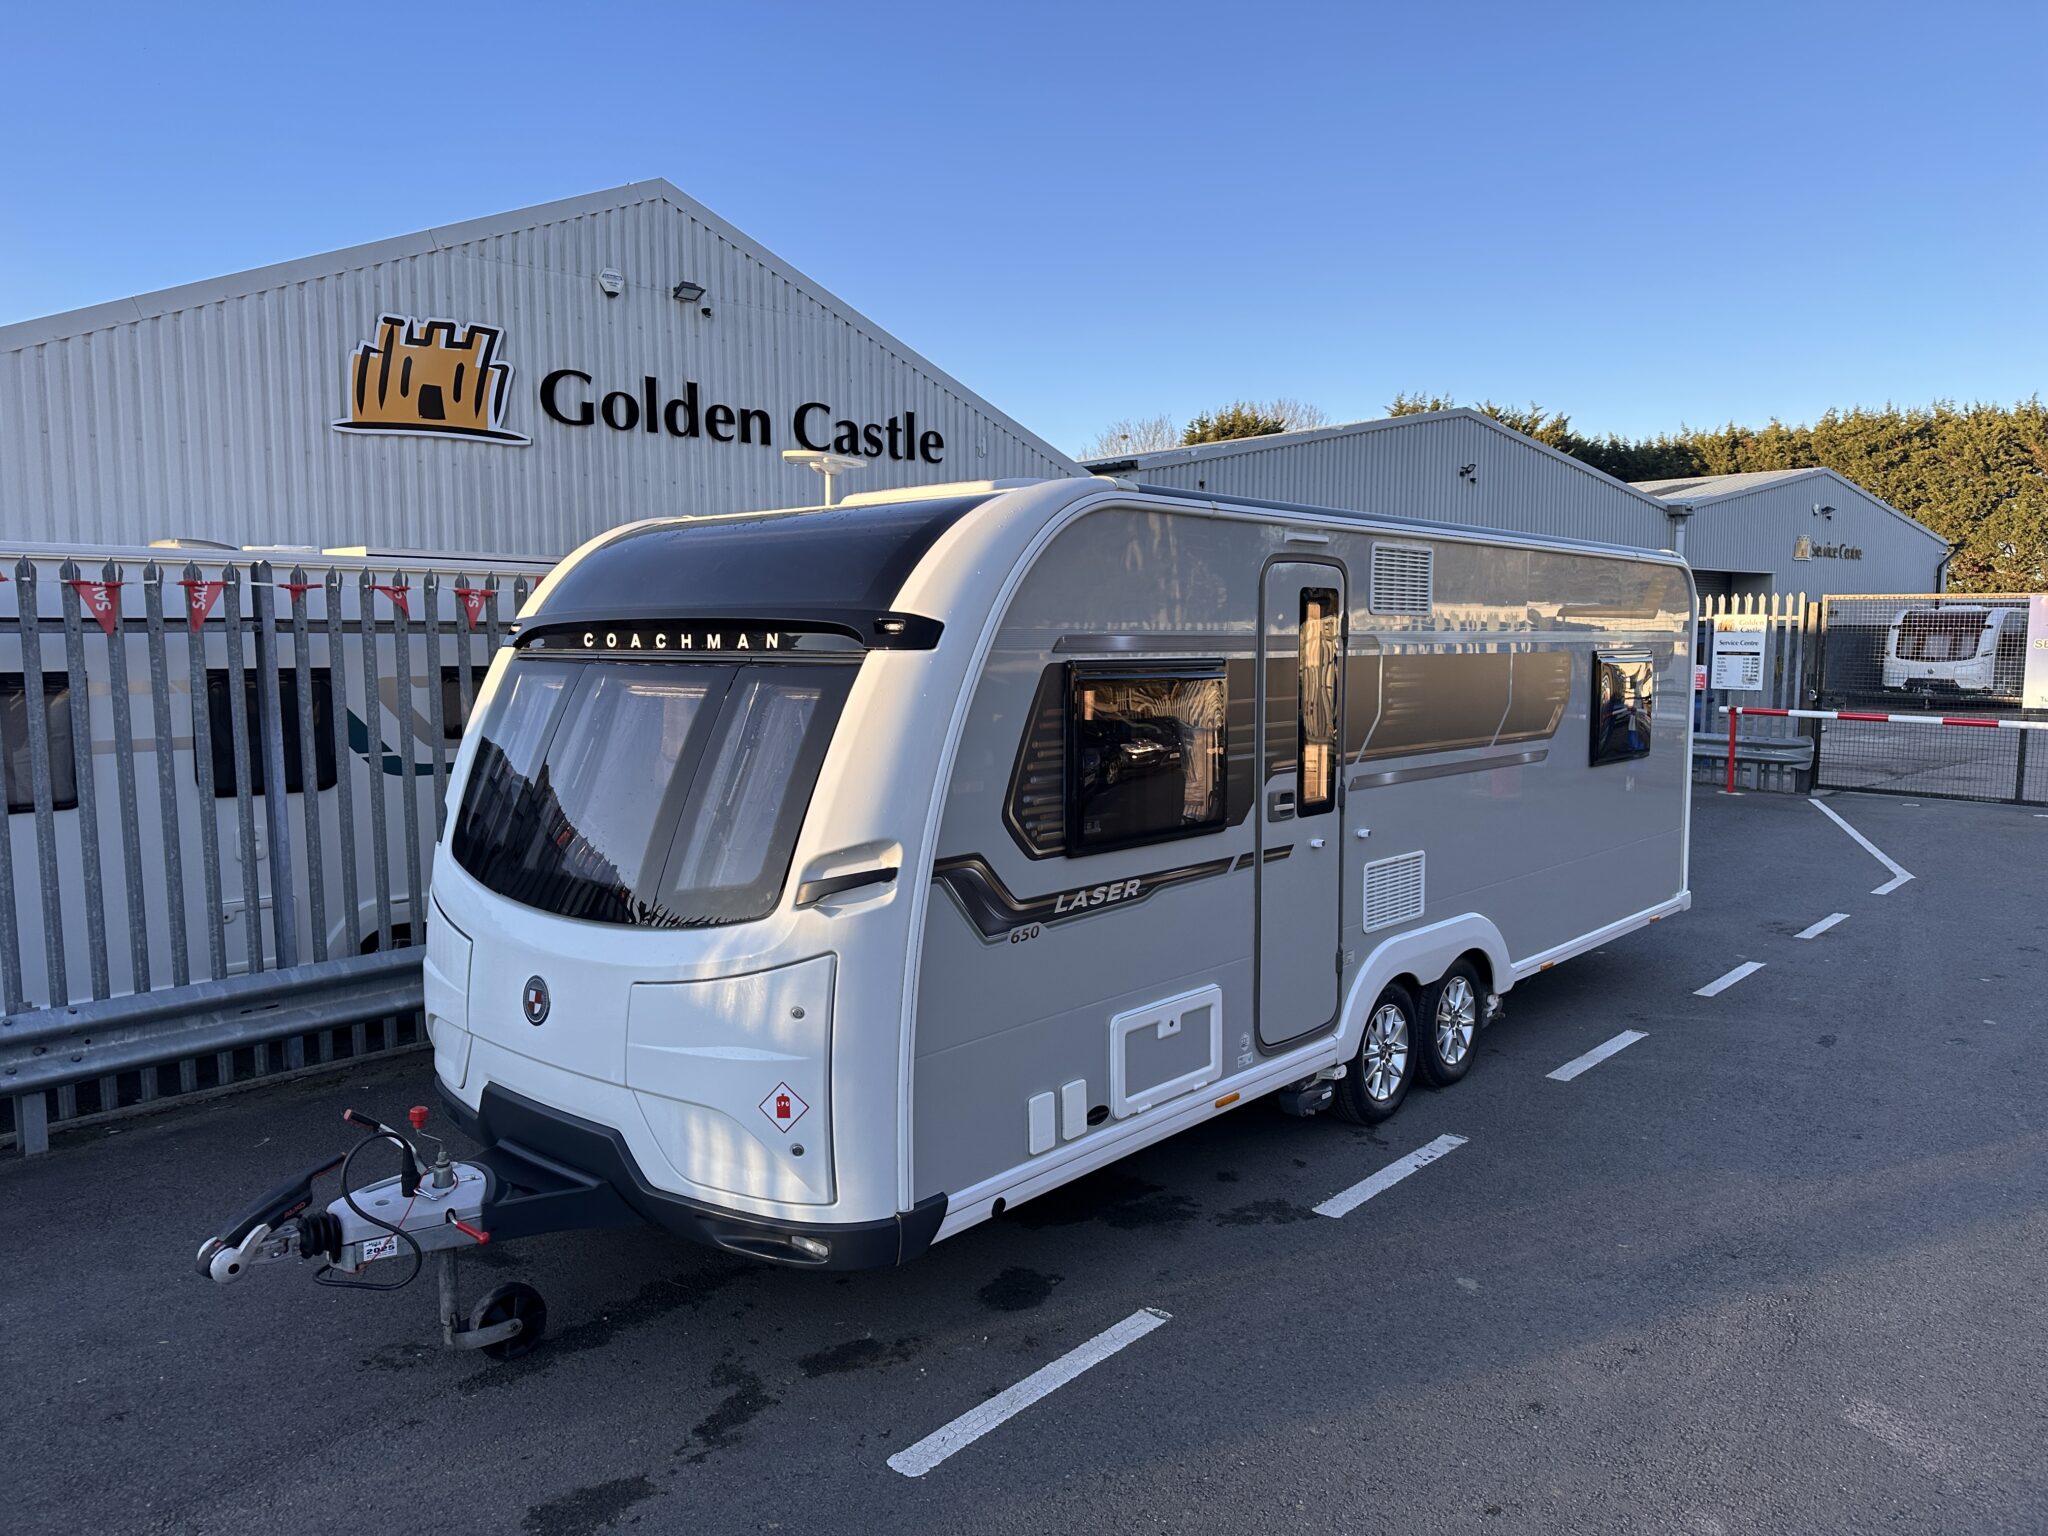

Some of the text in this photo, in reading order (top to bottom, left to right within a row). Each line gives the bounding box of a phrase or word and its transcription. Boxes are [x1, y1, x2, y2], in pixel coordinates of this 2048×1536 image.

[540, 369, 945, 464] Golden Castle
[1739, 618, 1764, 626] Golden
[583, 633, 779, 649] COACHMAN
[1054, 879, 1141, 914] LASER
[1010, 925, 1040, 944] 650
